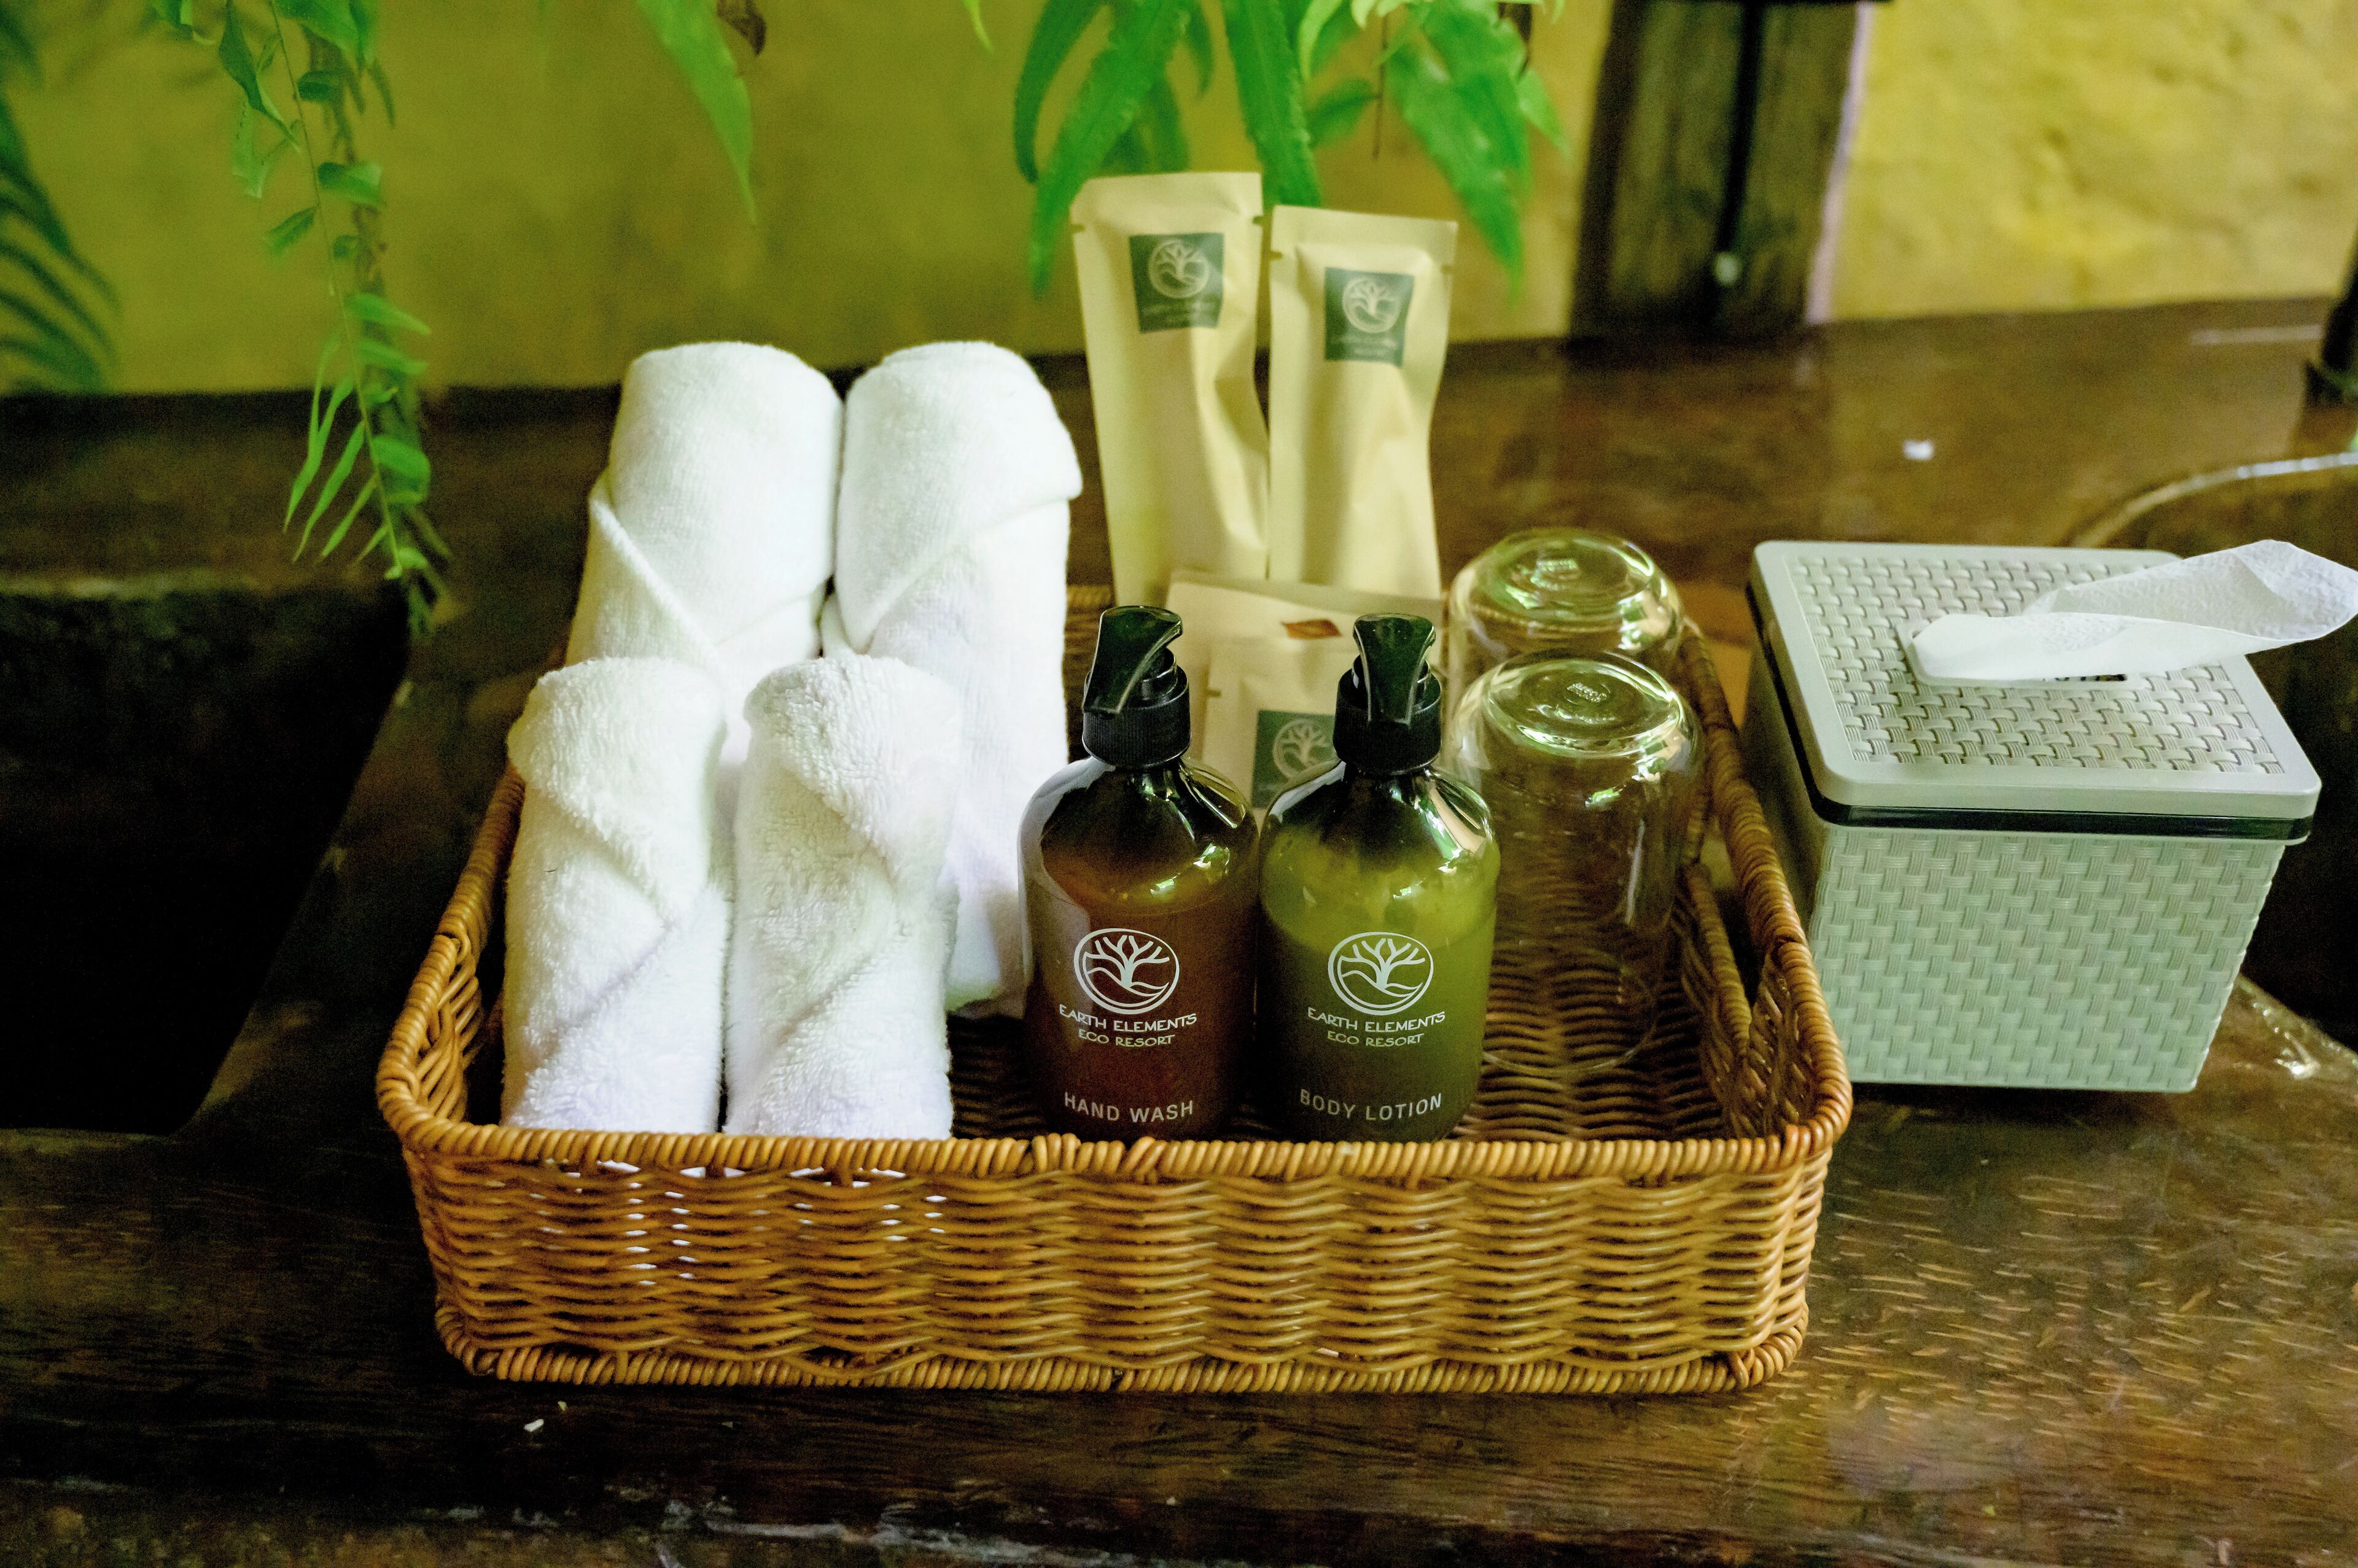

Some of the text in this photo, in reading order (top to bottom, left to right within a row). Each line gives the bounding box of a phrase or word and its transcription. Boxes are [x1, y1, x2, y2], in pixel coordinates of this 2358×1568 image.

[1059, 1004, 1197, 1032] EARTH ELEMENTS
[1307, 1007, 1445, 1032] EARTH ELEMENTS
[1078, 1029, 1175, 1047] ECO RESORT
[1328, 1031, 1425, 1047] ECO RESORT
[1064, 1092, 1193, 1122] HAND WASH
[1301, 1089, 1441, 1120] BODY LOTION
